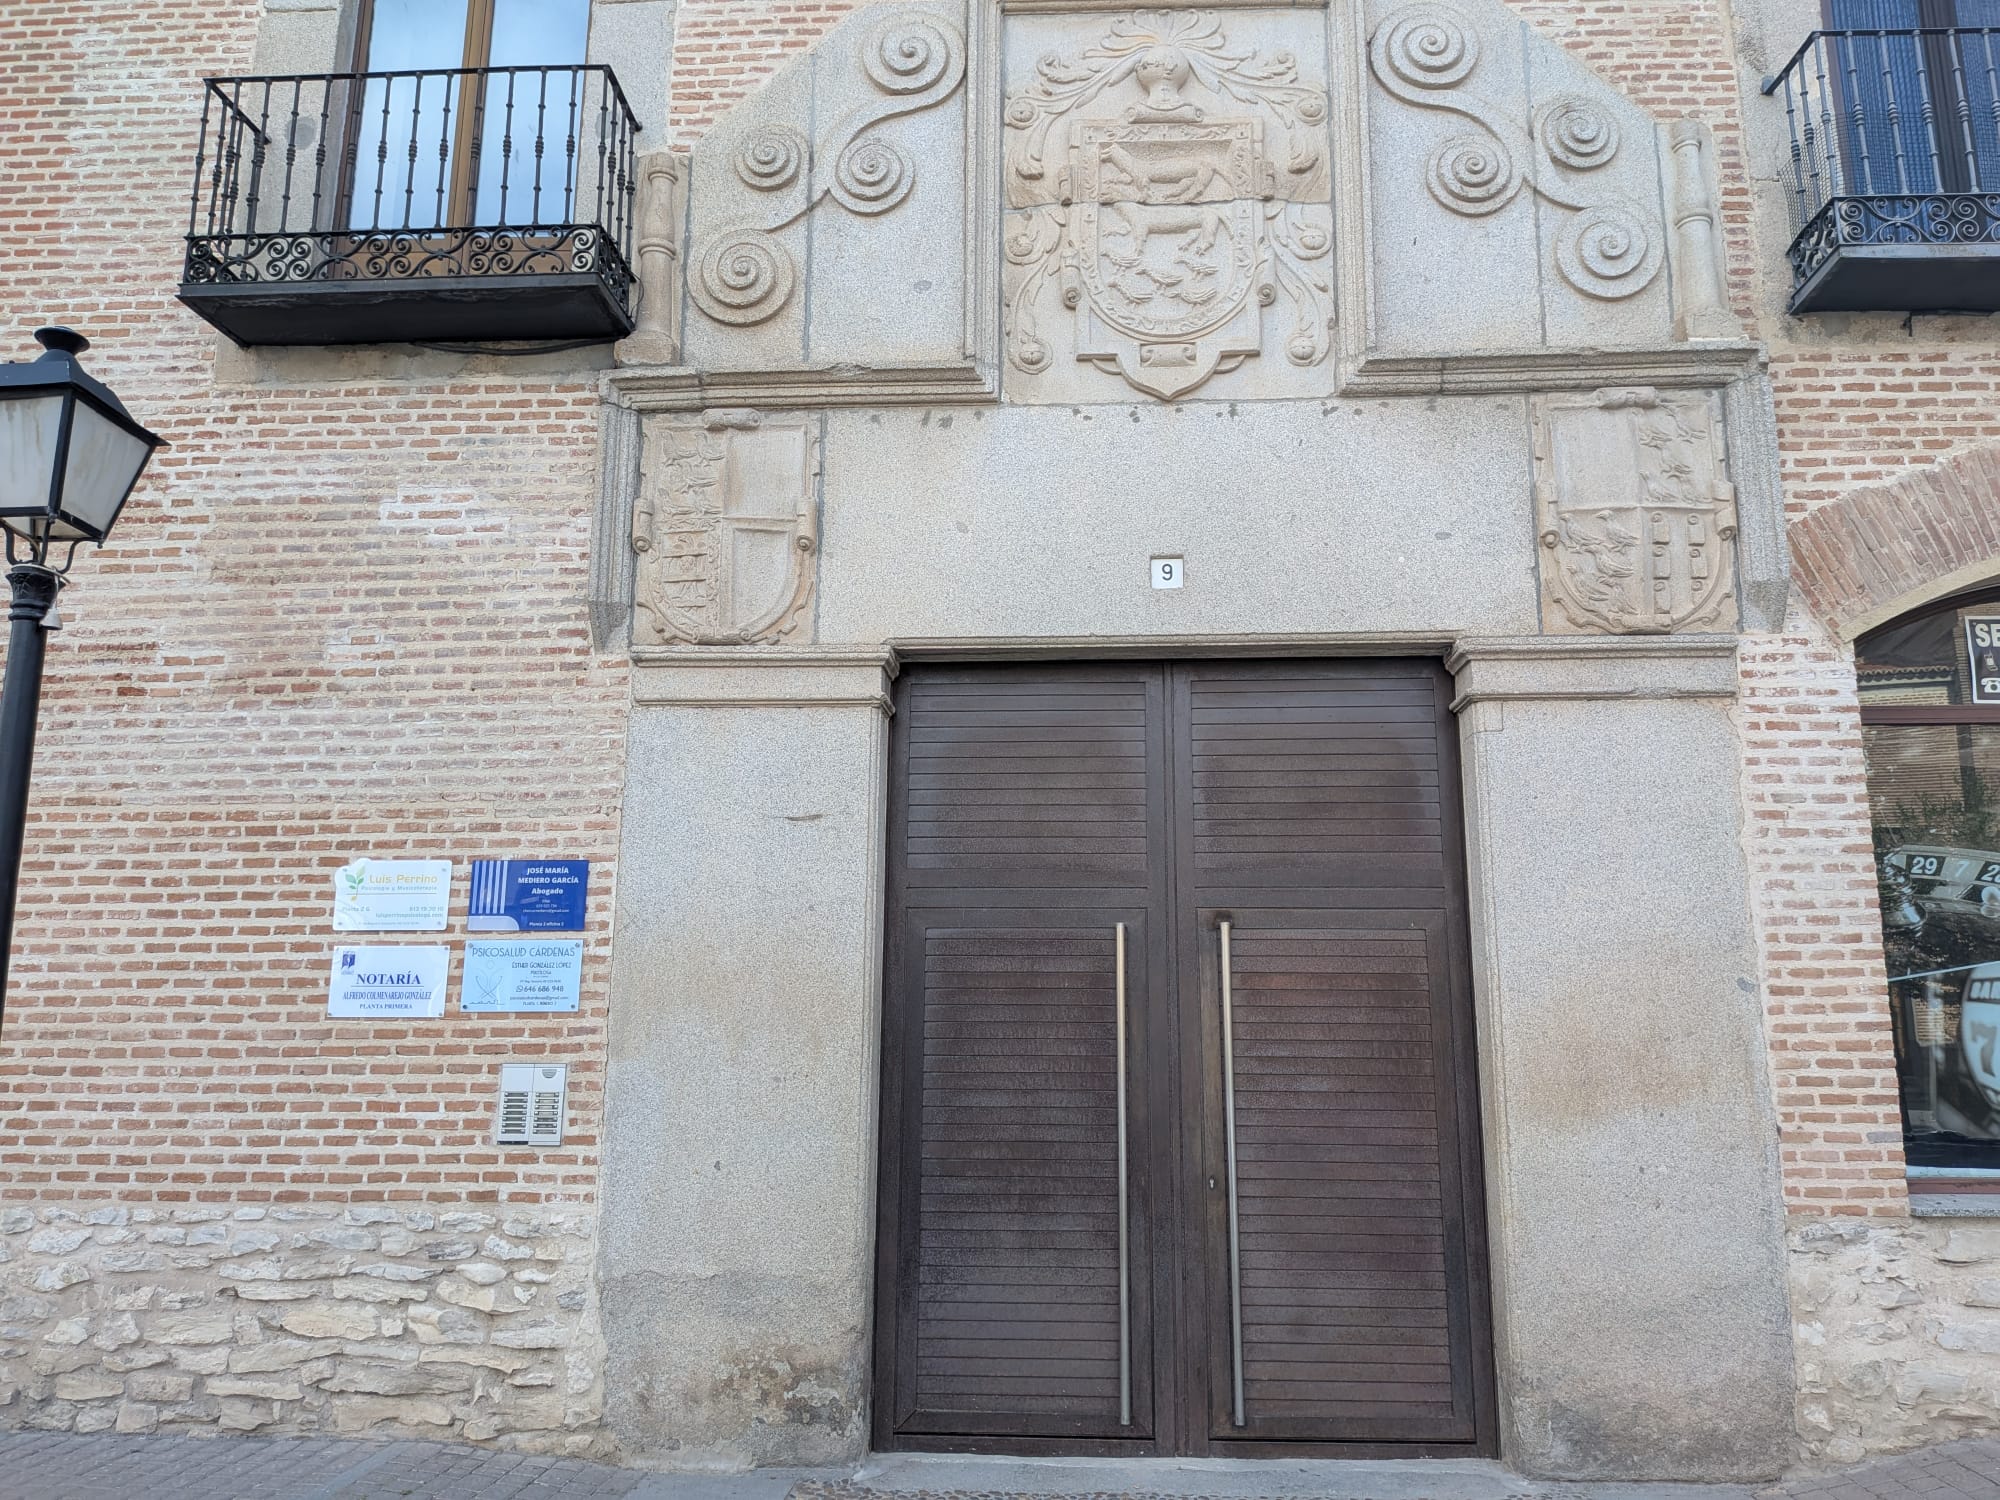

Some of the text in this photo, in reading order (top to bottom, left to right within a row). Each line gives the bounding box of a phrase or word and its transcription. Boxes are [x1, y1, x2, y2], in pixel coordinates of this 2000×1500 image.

[1162, 563, 1173, 581] 9
[526, 866, 569, 876] JOSÉ MARÍA
[1910, 856, 1938, 875] 29
[1955, 860, 1970, 878] 7
[369, 874, 438, 884] Luis Perrino
[551, 876, 579, 884] GARCÍA
[531, 888, 564, 896] Abogado
[472, 947, 526, 958] PSICOSALUD
[357, 970, 421, 985] NOTARÍA
[343, 988, 432, 1000] ALFREDO COLMENAREJO GONZÁLEZ
[1970, 1020, 1997, 1078] 7
